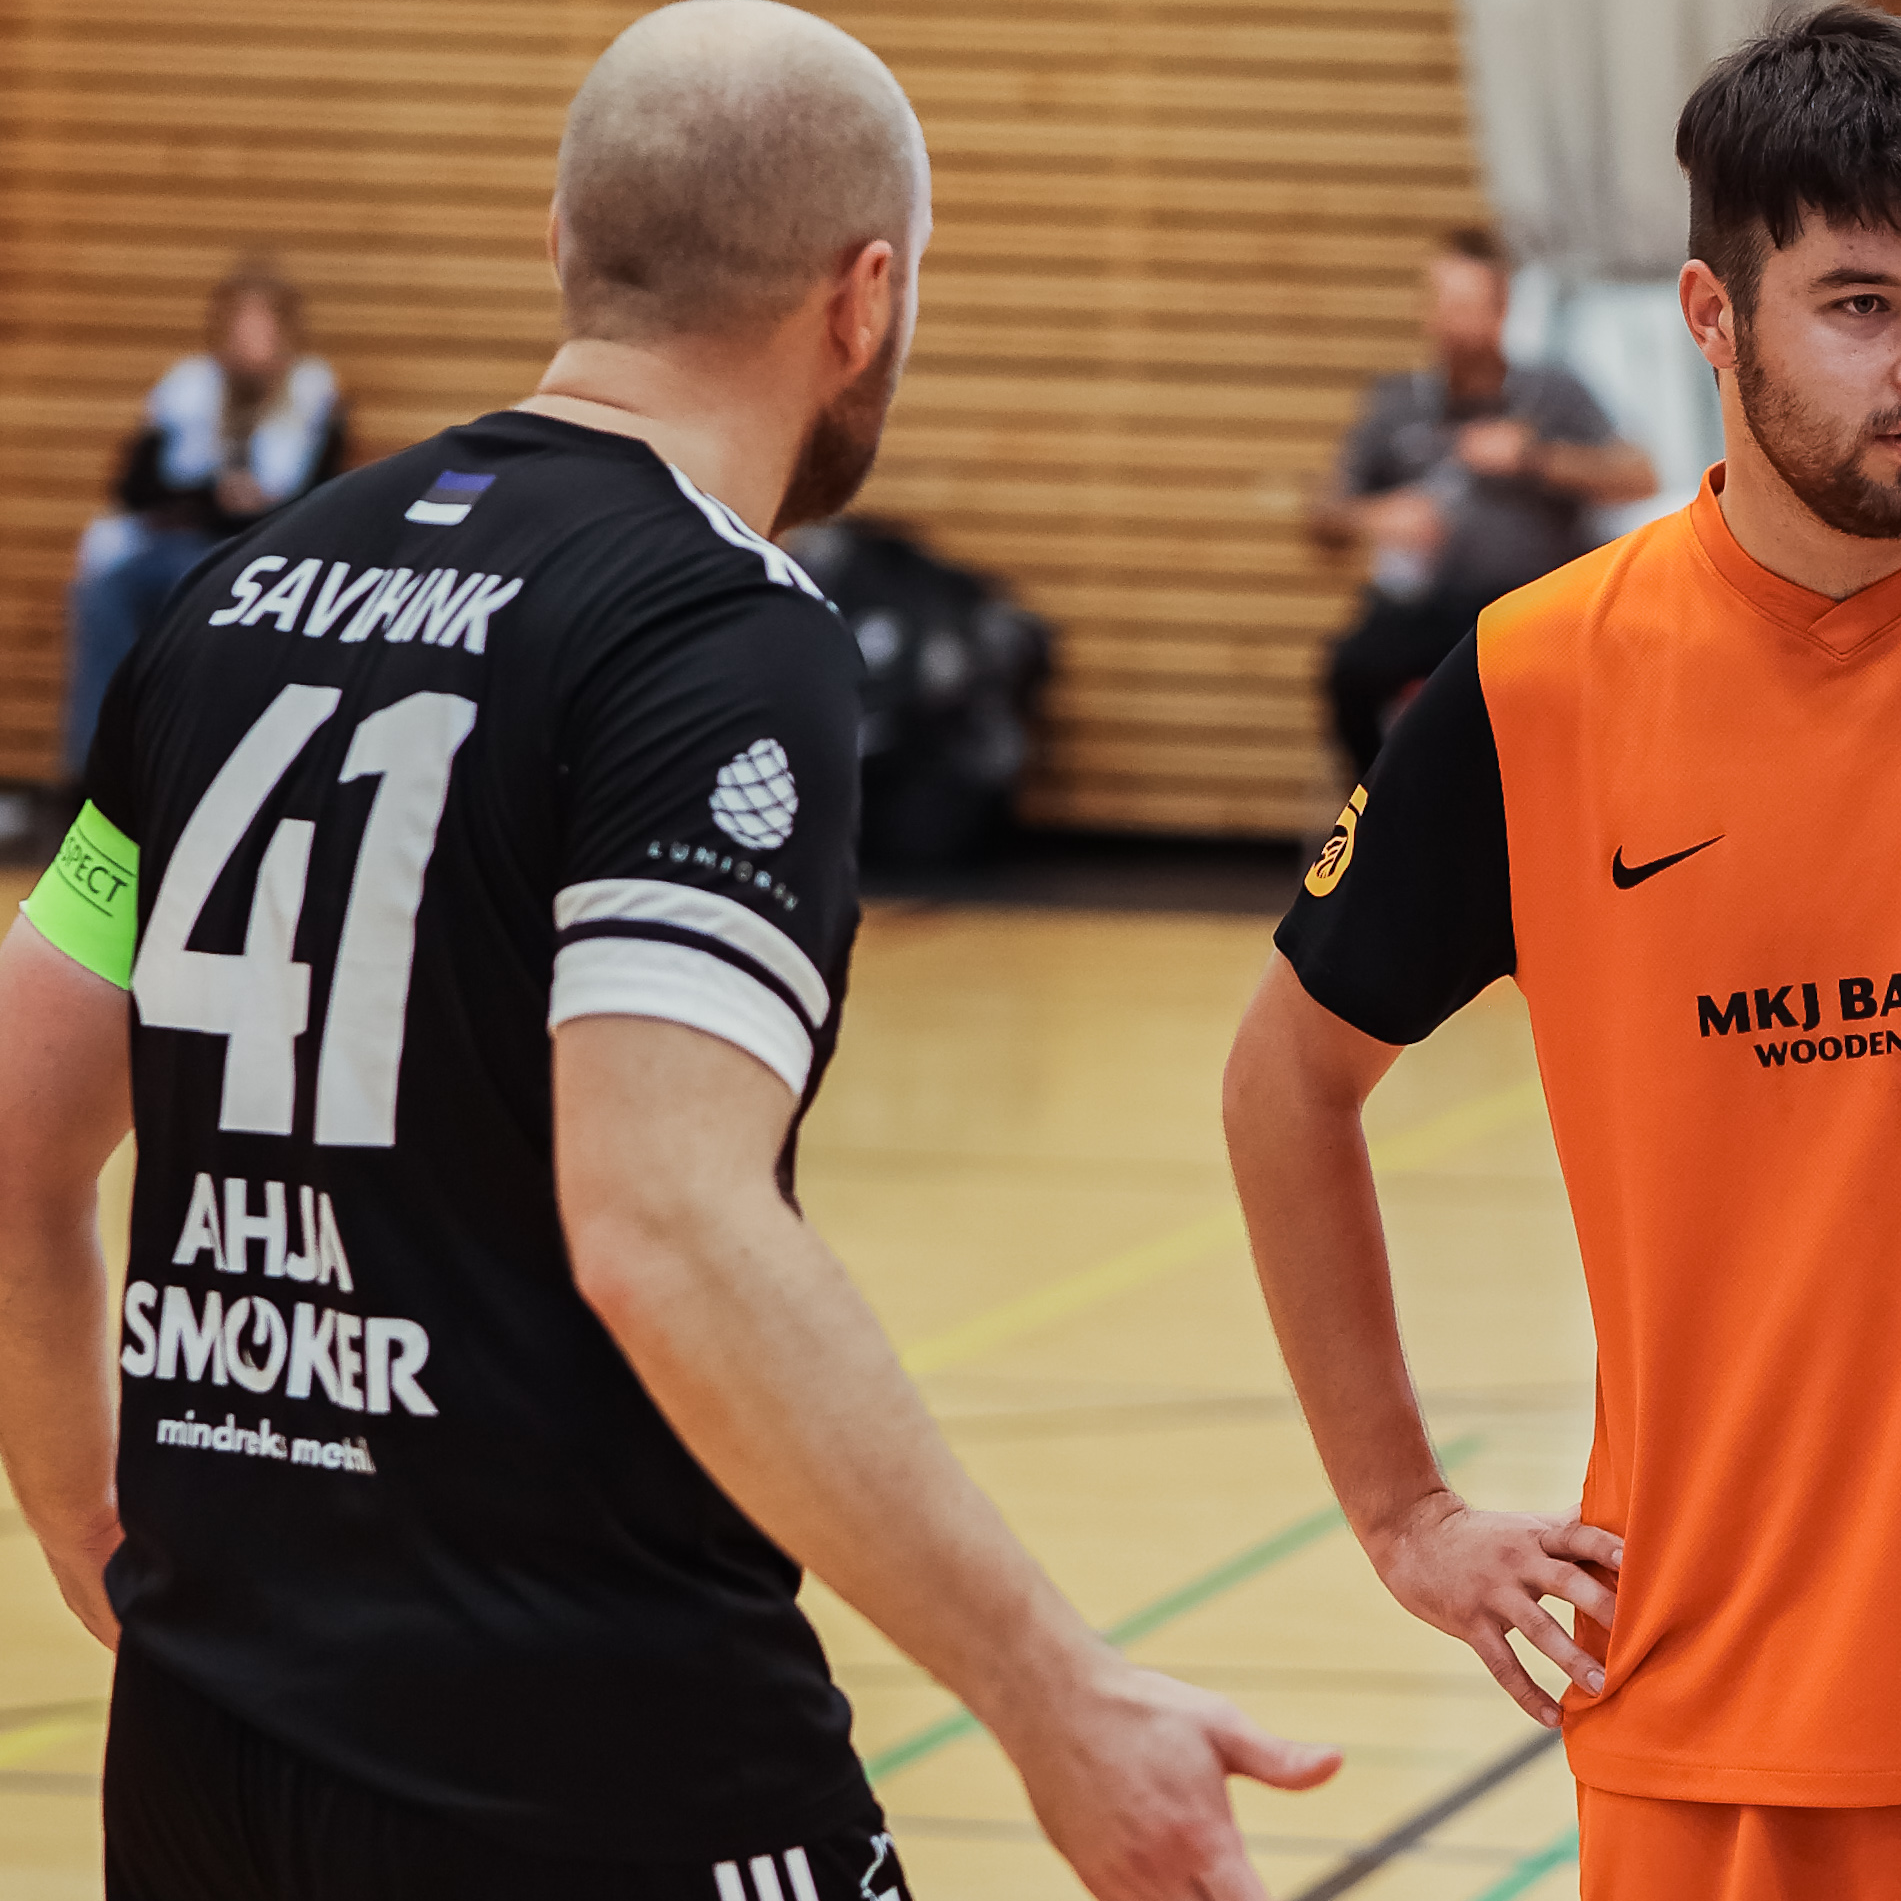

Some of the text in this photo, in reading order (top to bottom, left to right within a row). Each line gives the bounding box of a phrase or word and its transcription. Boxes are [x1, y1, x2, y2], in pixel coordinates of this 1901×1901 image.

[131, 682, 479, 1148] 41
[1696, 981, 1822, 1038] MKJ
[171, 1172, 355, 1293] AHJA
[121, 1279, 440, 1418] SMOKER
